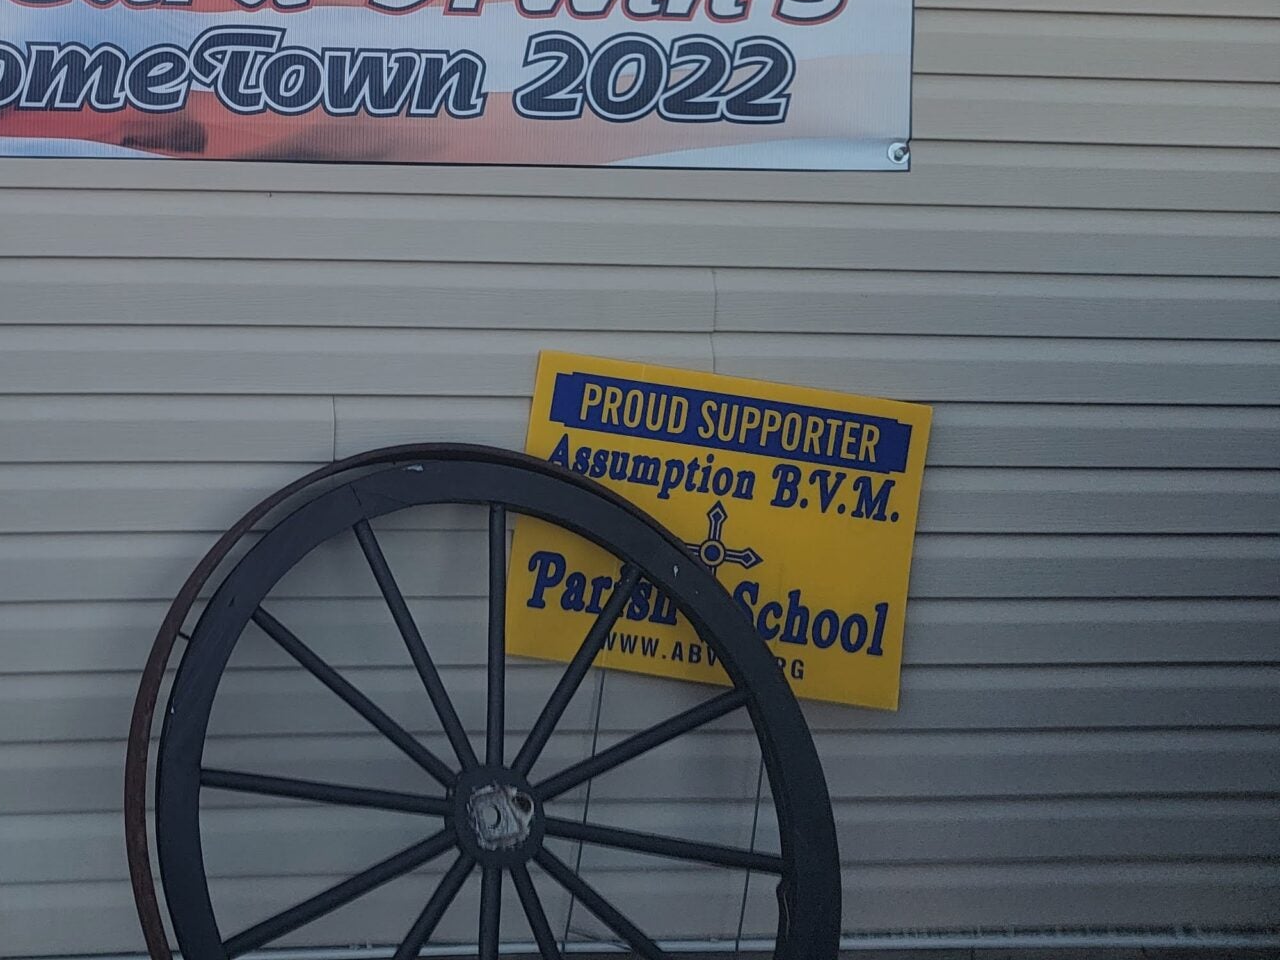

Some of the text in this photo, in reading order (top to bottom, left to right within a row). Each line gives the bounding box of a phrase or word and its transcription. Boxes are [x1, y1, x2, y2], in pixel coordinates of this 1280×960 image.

[513, 31, 795, 124] 2022
[579, 383, 880, 463] PROUD SUPPORTER
[548, 433, 899, 523] Assumption B.V.M.
[527, 551, 888, 656] Parsh School
